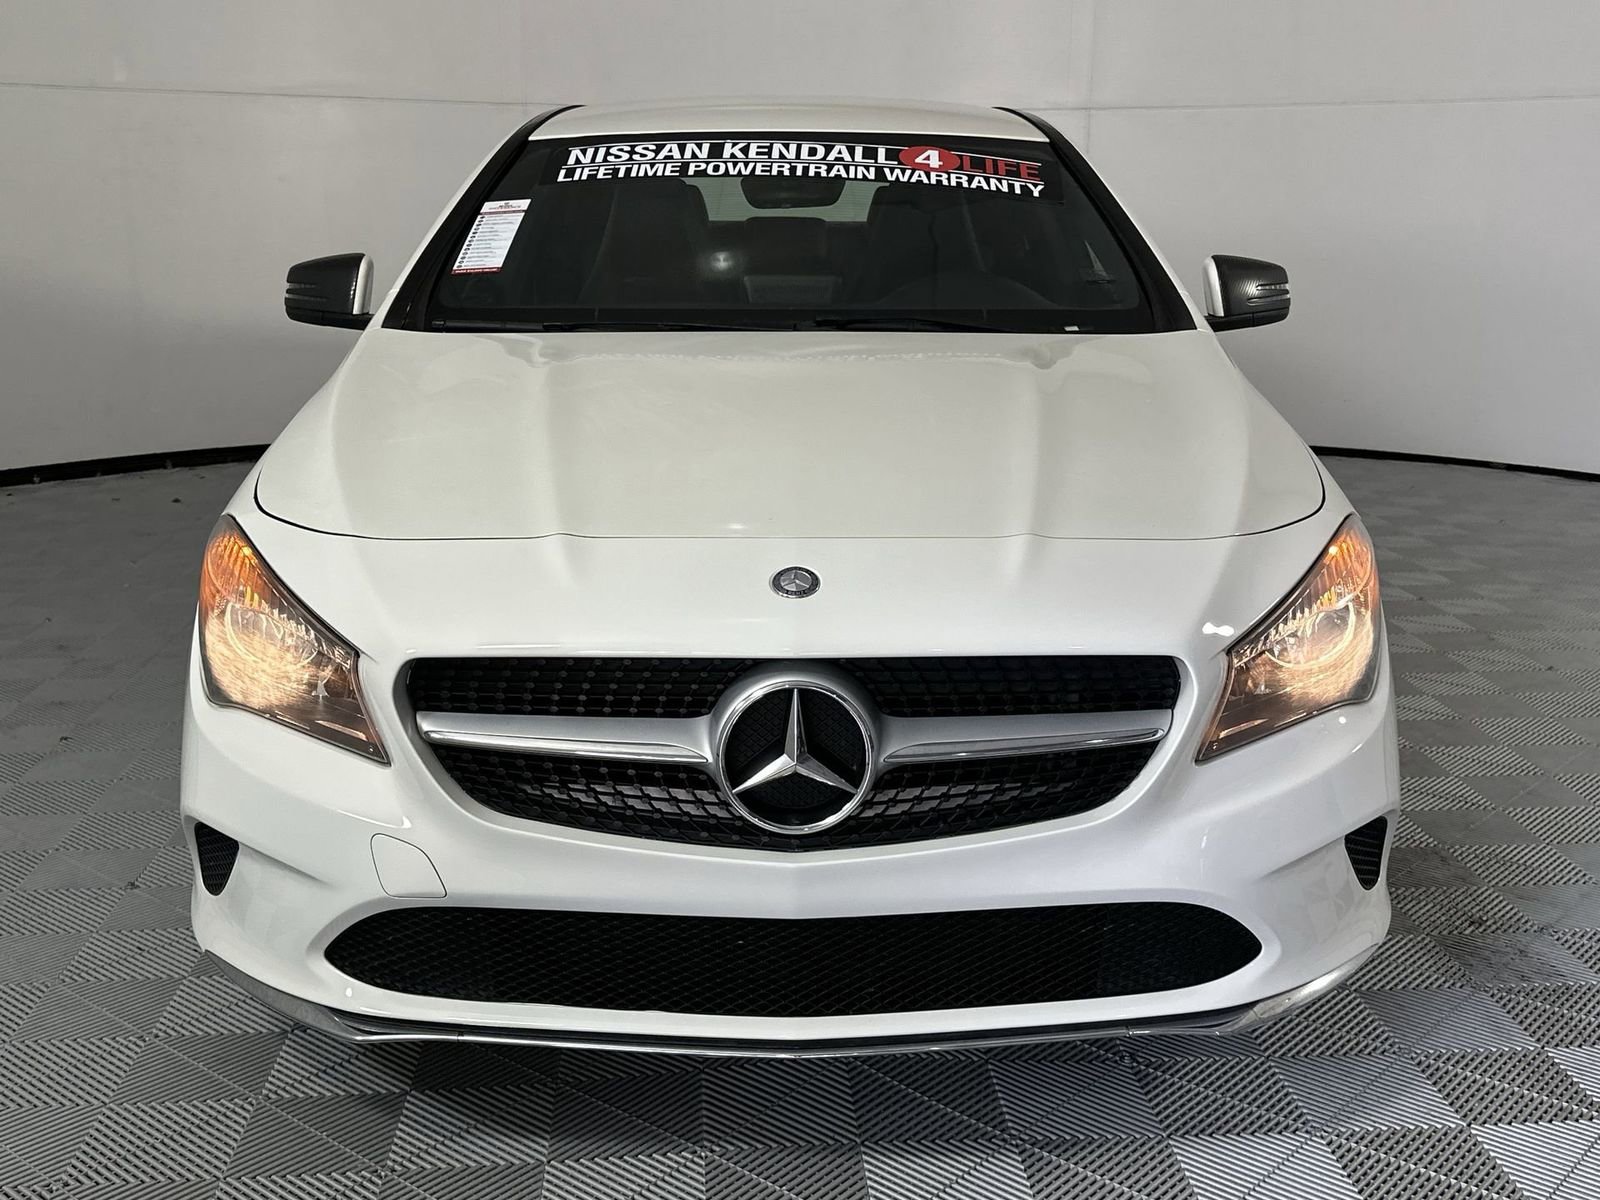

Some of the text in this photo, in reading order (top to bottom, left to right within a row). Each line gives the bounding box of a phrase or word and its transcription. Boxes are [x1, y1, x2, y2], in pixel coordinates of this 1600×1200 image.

[557, 162, 1044, 198] LIFETIME POWERTRAIN WARRANTY
[567, 143, 1041, 181] NISSAN KENDALL 4 LIFE
